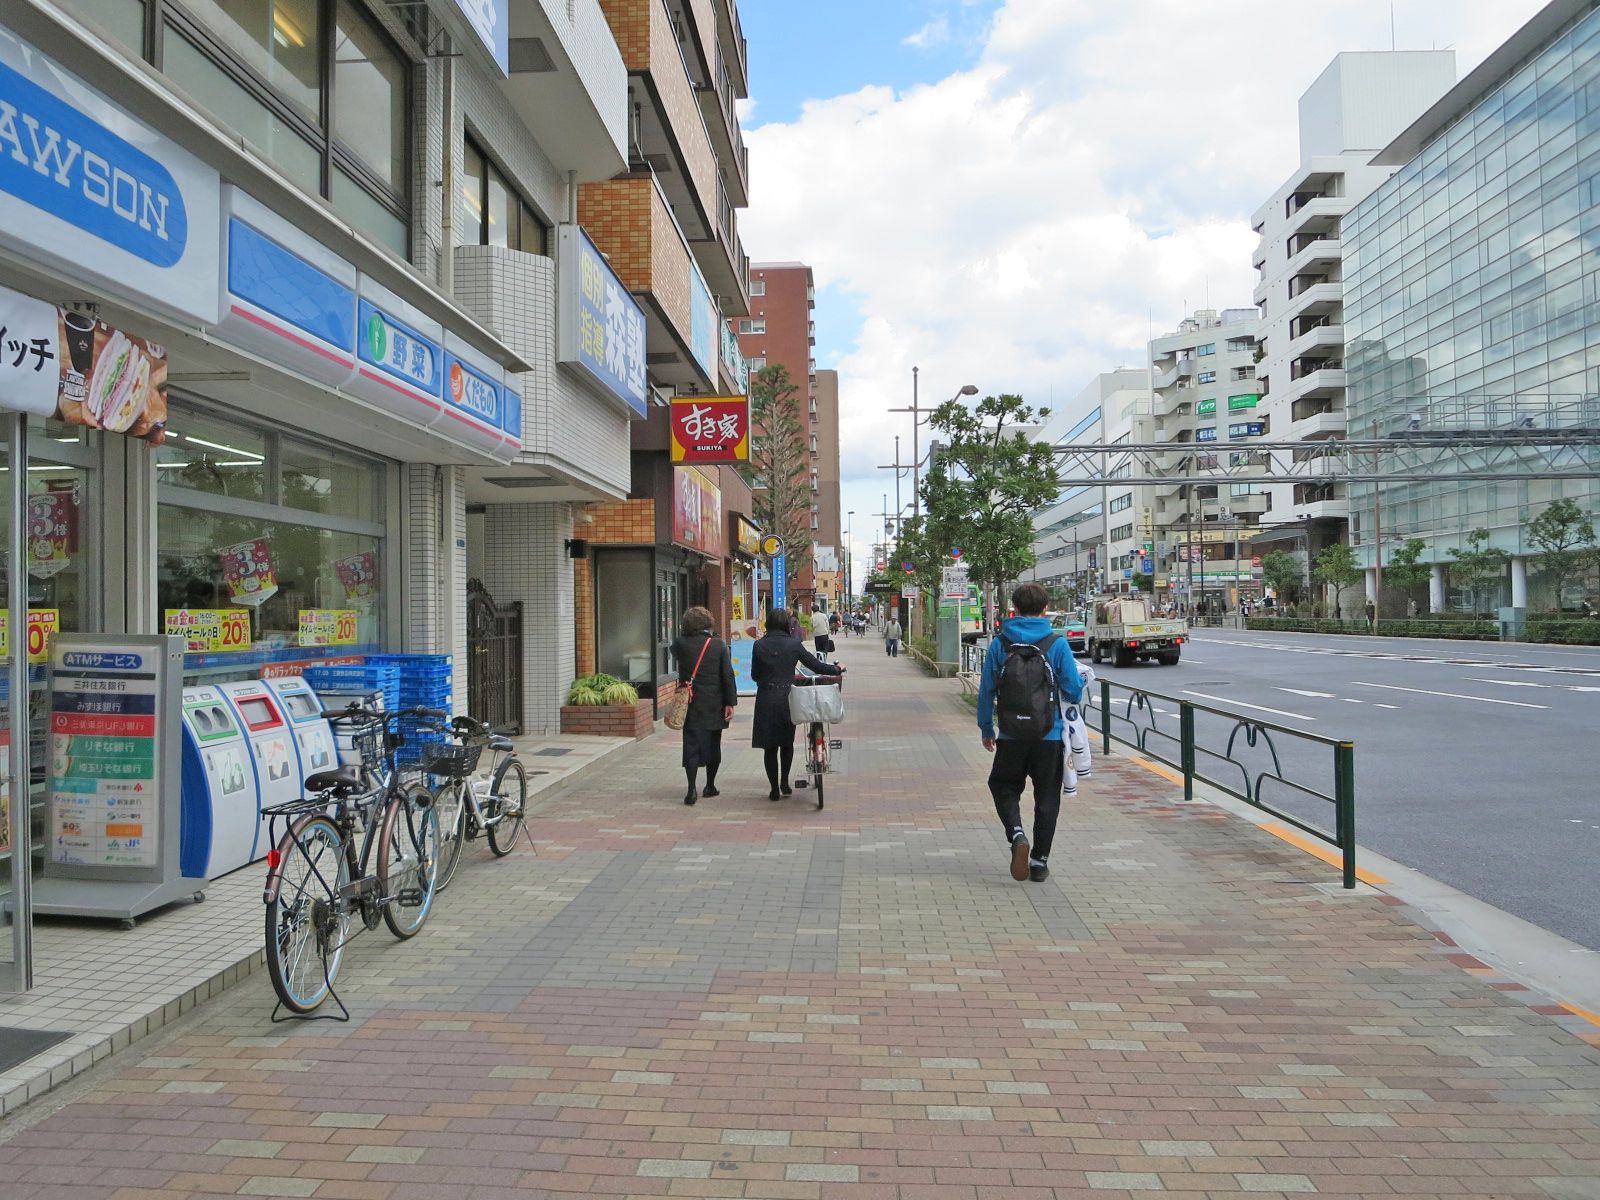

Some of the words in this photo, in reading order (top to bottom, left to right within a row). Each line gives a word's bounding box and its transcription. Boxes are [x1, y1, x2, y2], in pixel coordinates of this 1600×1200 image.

[581, 248, 604, 314] 個別
[393, 331, 425, 380] 野菜
[581, 304, 604, 367] 指導
[606, 281, 645, 402] 森塾
[465, 376, 494, 416] くだもの
[1200, 402, 1215, 410] レイク
[680, 403, 739, 444] すき家
[66, 653, 138, 668] ATMサービス
[73, 680, 126, 691] 三井住友銀行
[77, 702, 122, 712] みずほ銀行
[84, 741, 135, 752] りそな銀行
